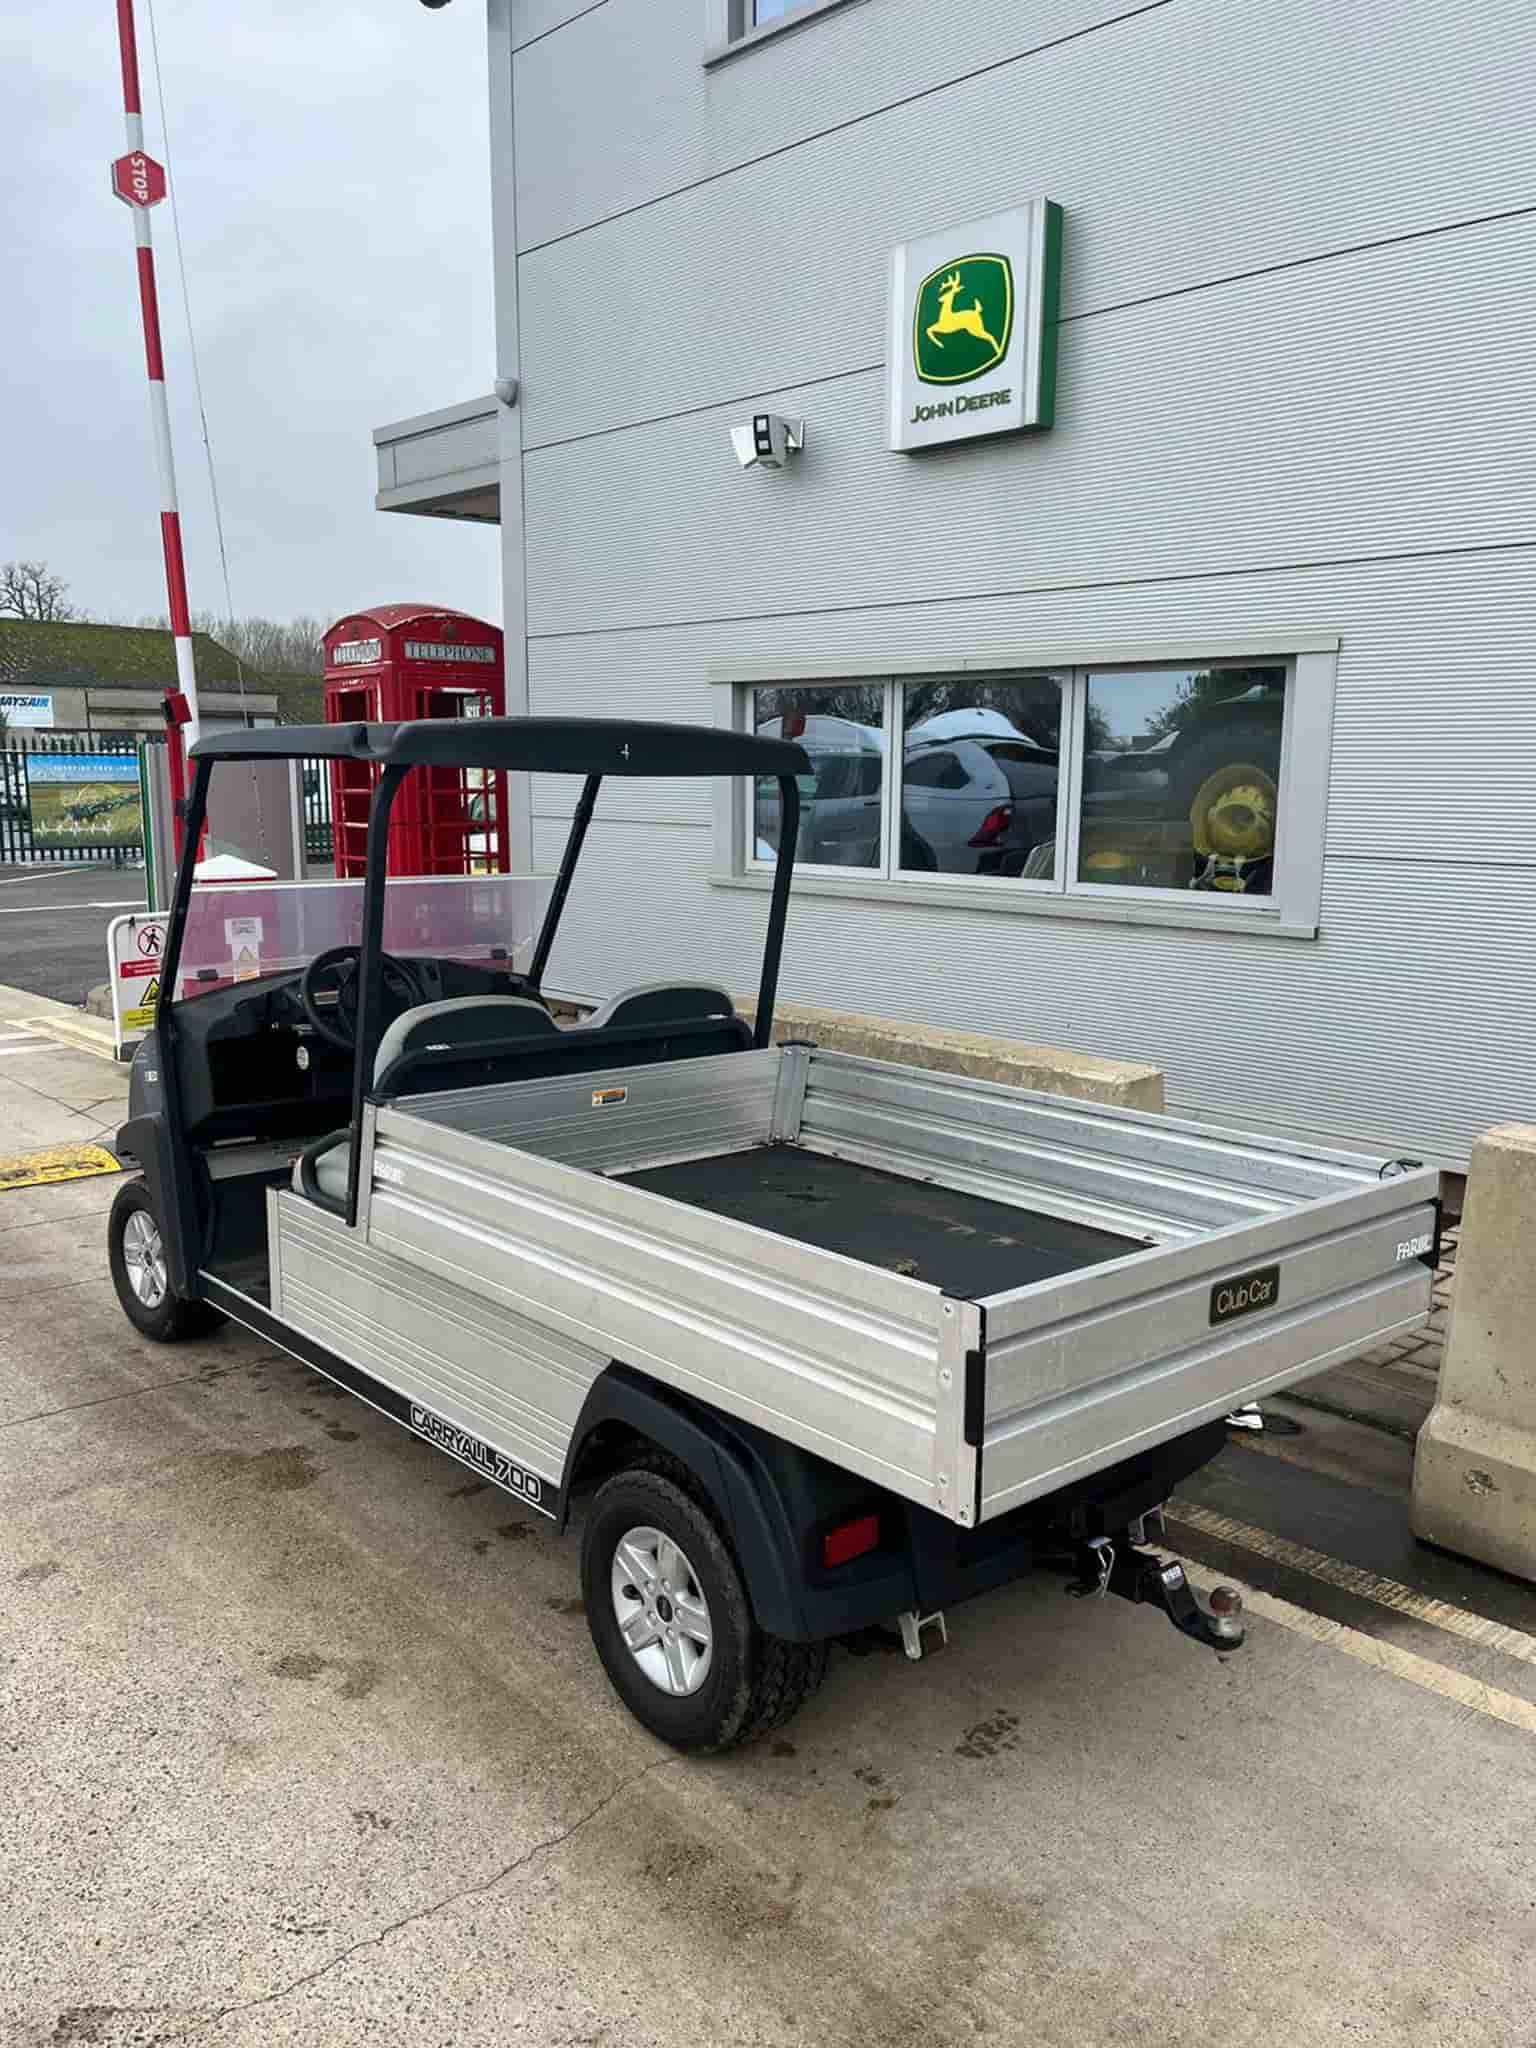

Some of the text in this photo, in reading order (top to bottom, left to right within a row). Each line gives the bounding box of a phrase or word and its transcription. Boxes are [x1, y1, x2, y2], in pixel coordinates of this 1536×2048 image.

[130, 157, 149, 201] STOP
[910, 389, 1012, 424] JOHN DEERE
[409, 643, 492, 662] TELEPHONE
[1216, 1279, 1274, 1313] Club Car
[410, 1402, 541, 1502] CARRYALL 700
